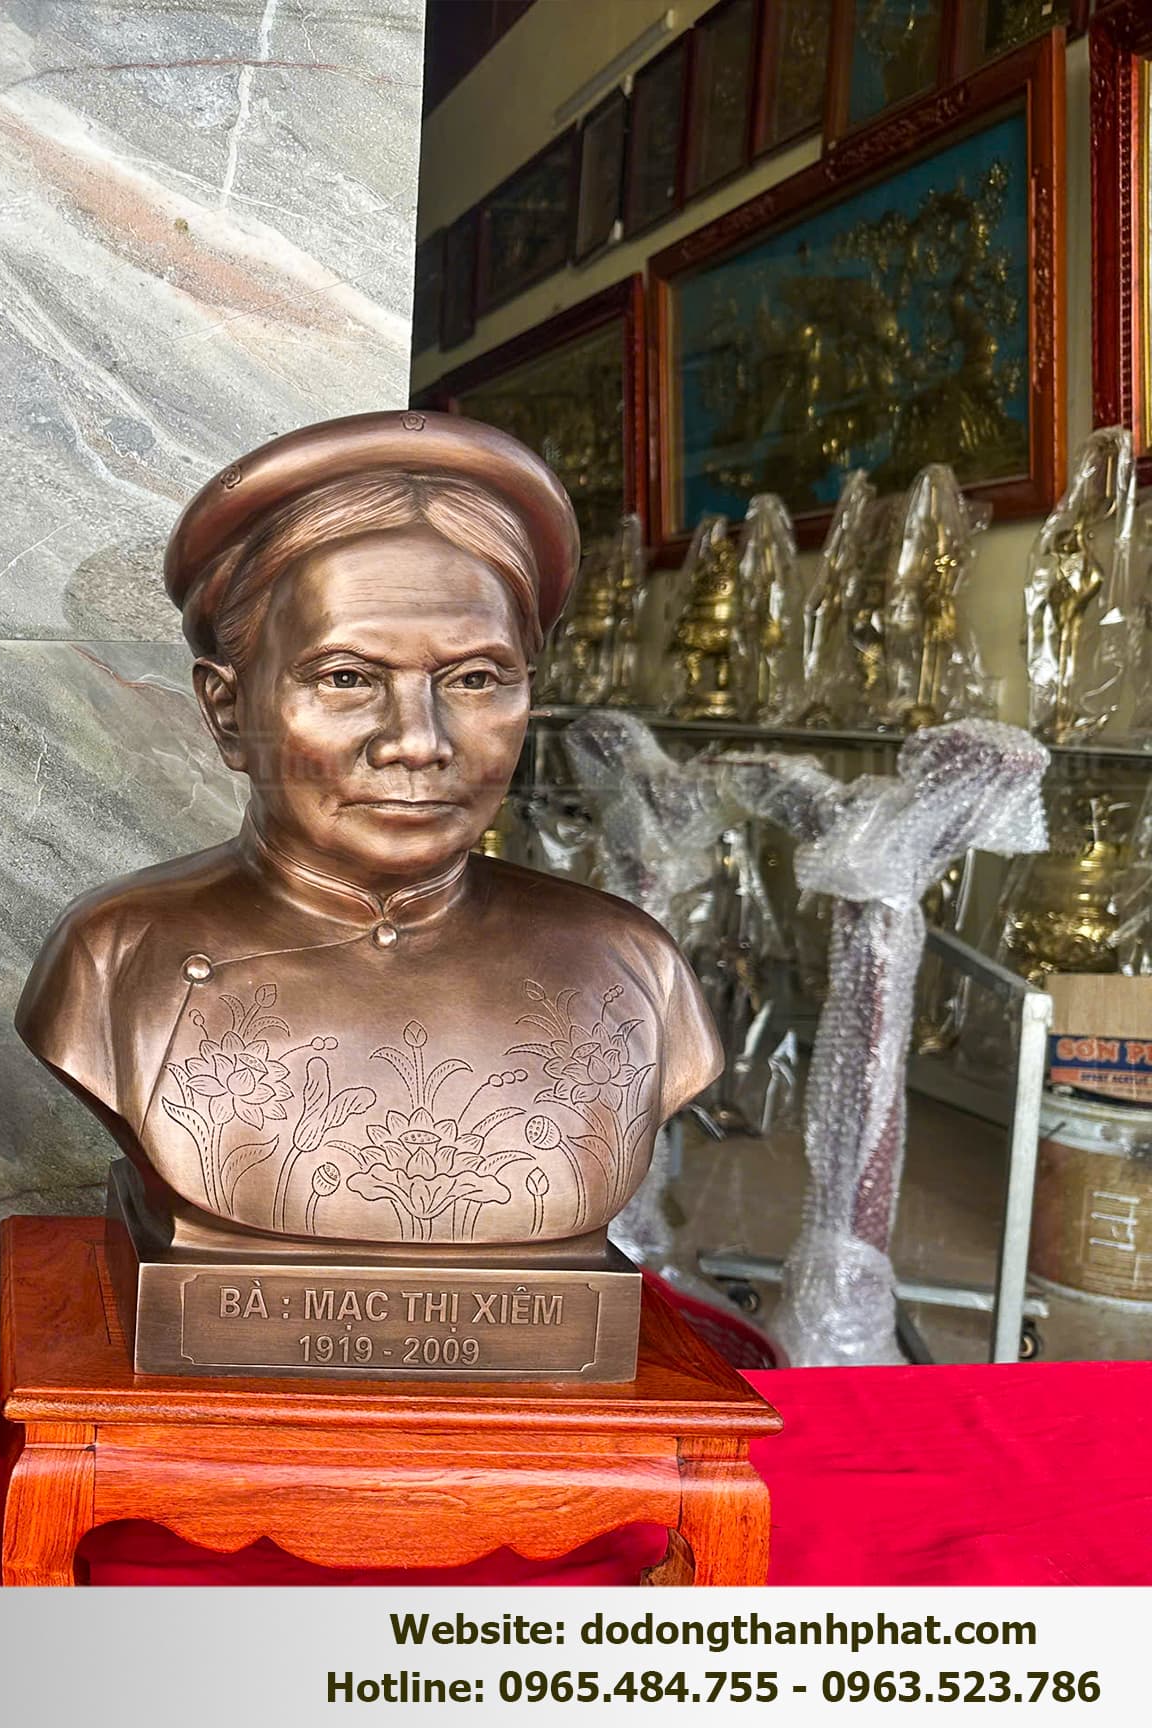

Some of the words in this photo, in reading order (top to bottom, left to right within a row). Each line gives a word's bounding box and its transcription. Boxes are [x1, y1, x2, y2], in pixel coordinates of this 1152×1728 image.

[219, 1281, 270, 1320] BÀ
[303, 1287, 389, 1332] MẠC
[400, 1291, 459, 1333] THỊ
[471, 1285, 564, 1325] XIÊM
[299, 1335, 373, 1364] 1919
[401, 1336, 480, 1365] 2009
